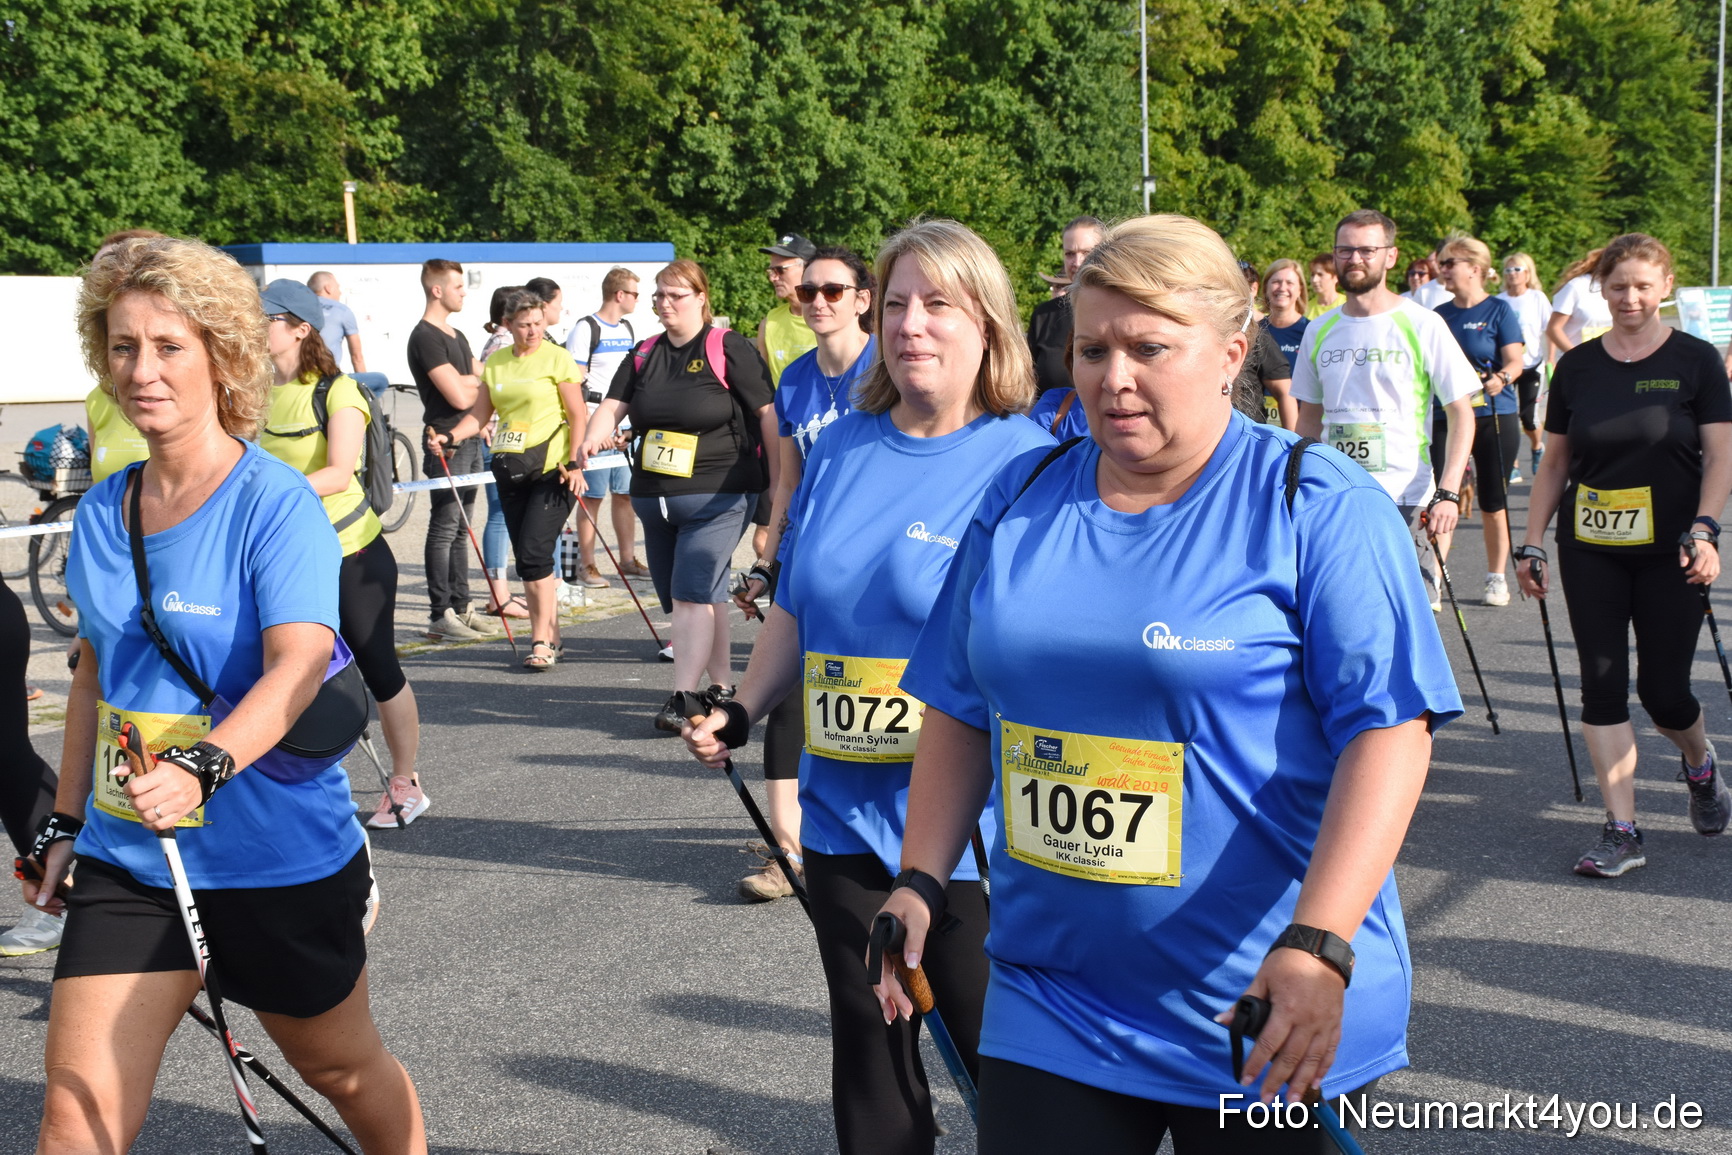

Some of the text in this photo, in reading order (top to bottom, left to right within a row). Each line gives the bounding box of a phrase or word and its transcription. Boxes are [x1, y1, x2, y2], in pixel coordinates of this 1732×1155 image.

[1281, 344, 1294, 352] vhs
[1321, 347, 1403, 368] gangart
[496, 432, 522, 443] 1194
[657, 446, 674, 462] 71
[1582, 507, 1640, 529] 2077
[929, 534, 959, 549] classic
[184, 602, 221, 616] classic
[1182, 636, 1235, 651] classic
[818, 673, 863, 688] firmenlauf
[816, 692, 910, 734] 1072
[825, 731, 899, 747] Hofmann Sylvia
[1024, 753, 1089, 777] firmenlauf
[1097, 773, 1169, 793] walk 2019
[1021, 778, 1154, 844] 1067
[1043, 833, 1123, 858] Gauer Lydia
[1055, 851, 1071, 862] IKK
[1073, 855, 1106, 868] classic
